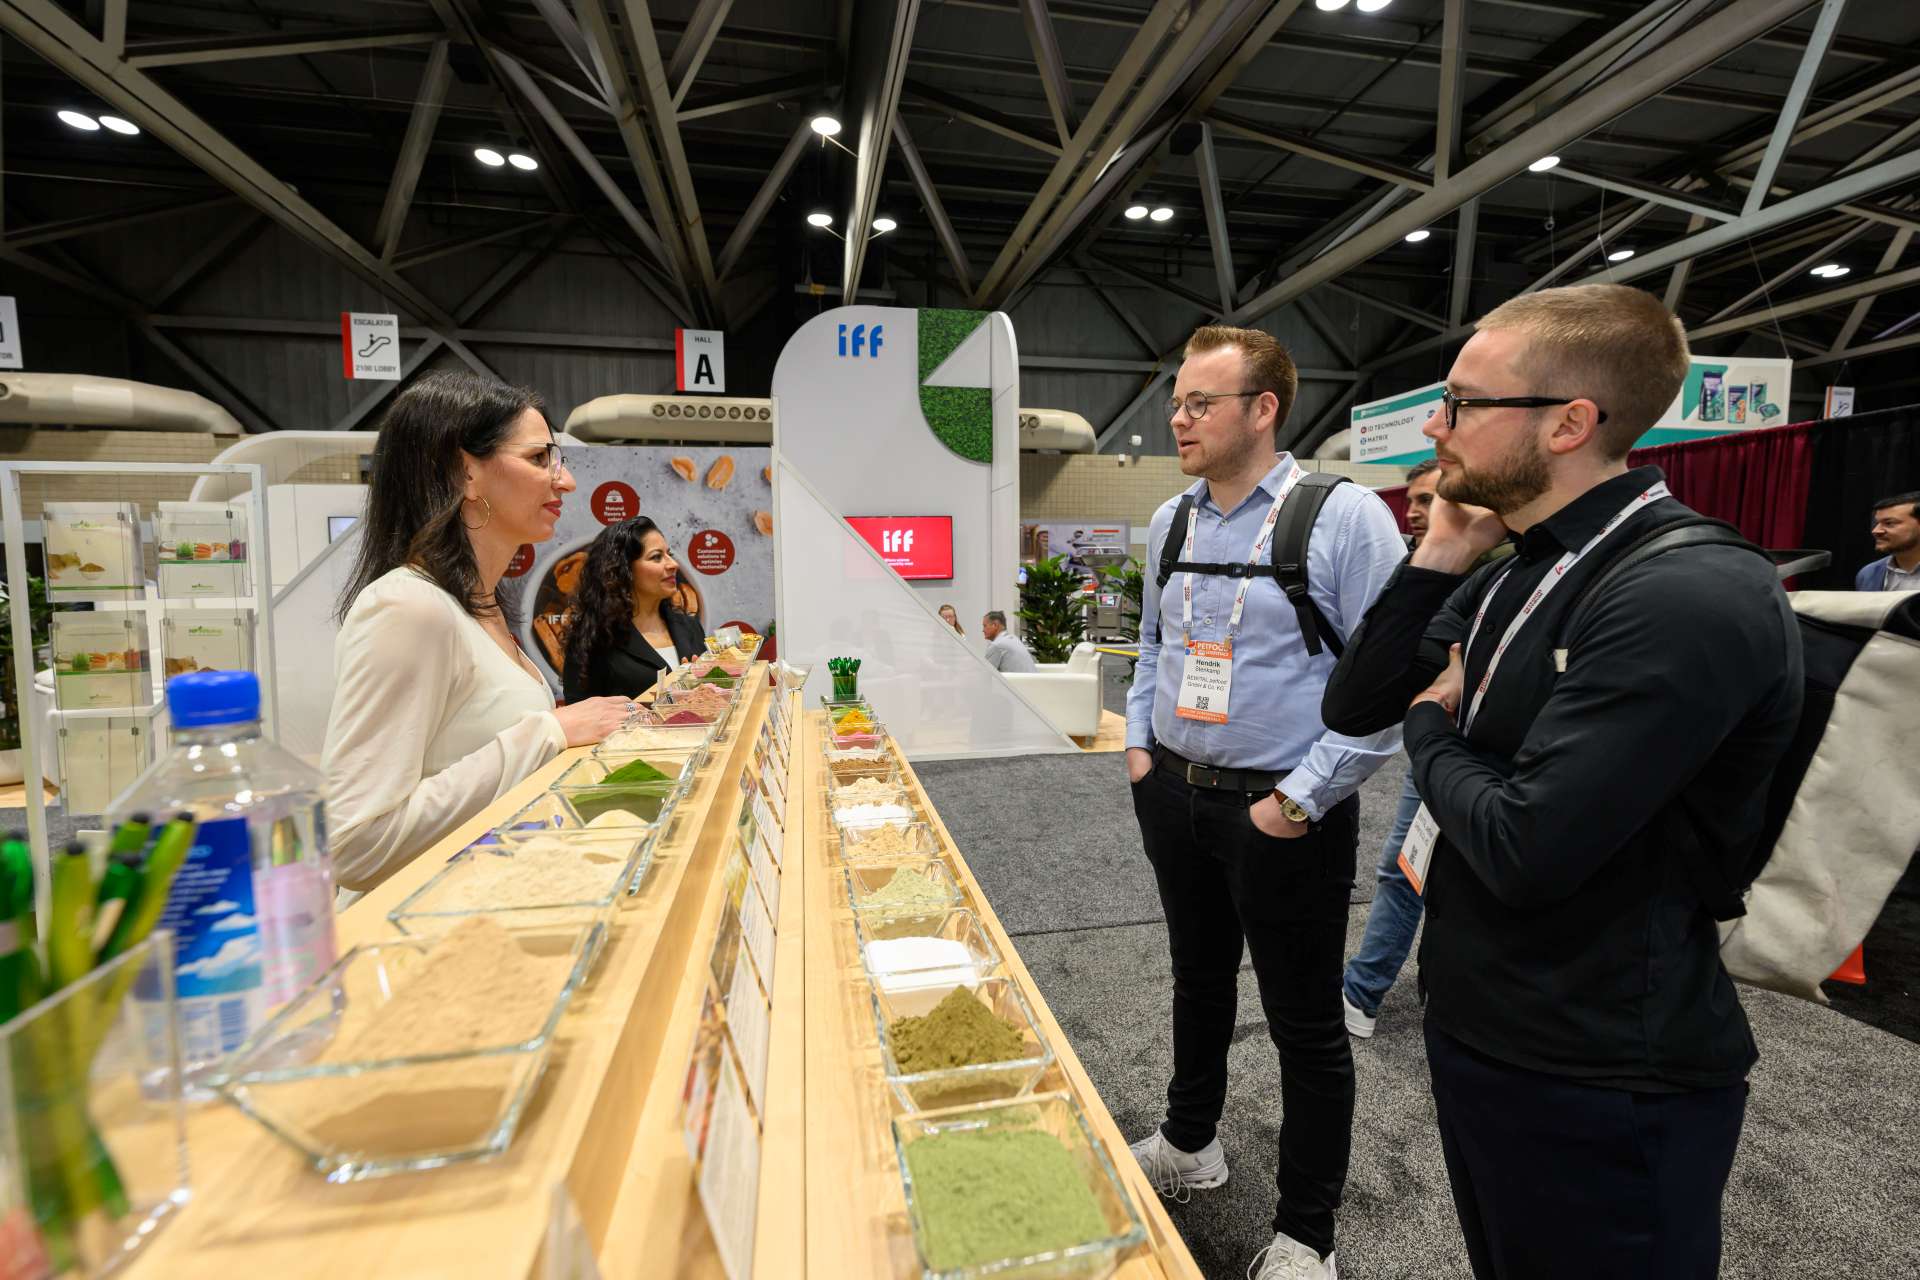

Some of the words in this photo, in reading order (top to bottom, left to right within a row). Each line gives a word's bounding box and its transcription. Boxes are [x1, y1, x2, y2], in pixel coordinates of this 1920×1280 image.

[694, 336, 712, 344] HALL
[838, 324, 883, 358] iff
[374, 365, 397, 373] LOBBY
[694, 353, 716, 385] A
[1375, 416, 1415, 431] TECHNOLOGY
[1367, 434, 1389, 442] MATRIX
[882, 529, 914, 553] iff
[1196, 659, 1221, 668] Hendrik
